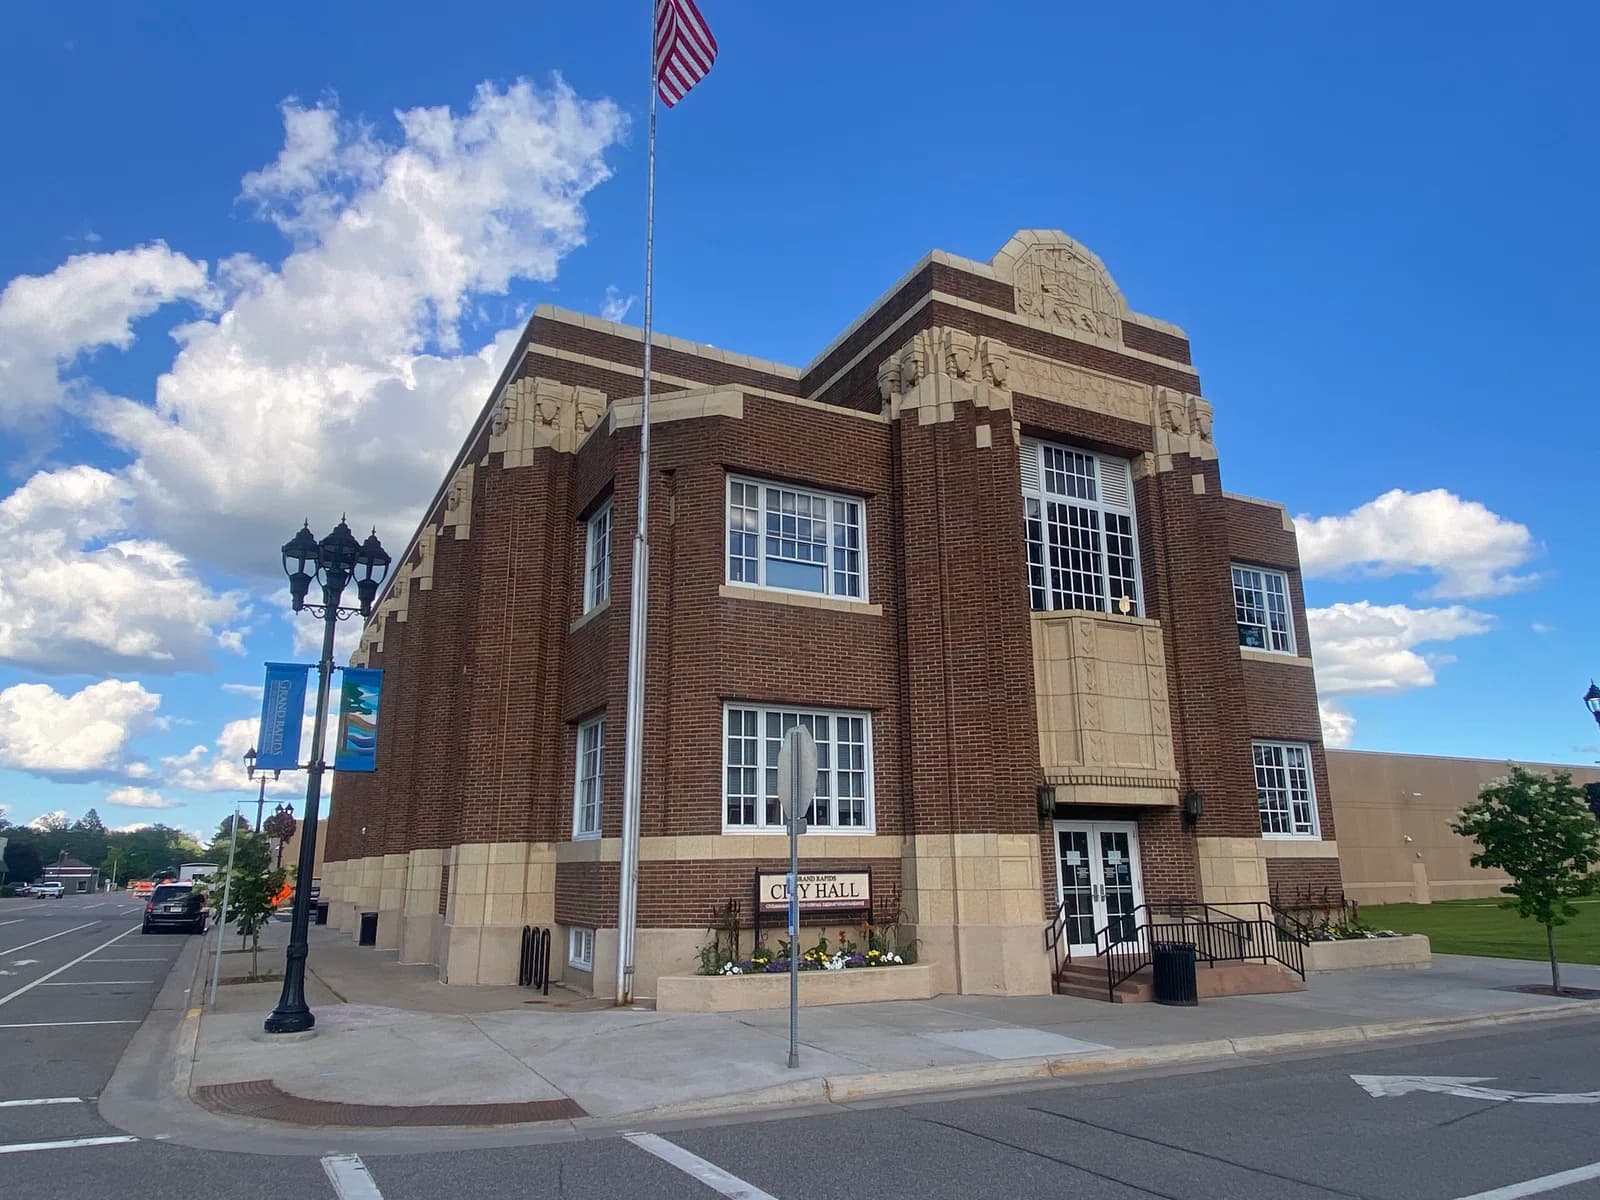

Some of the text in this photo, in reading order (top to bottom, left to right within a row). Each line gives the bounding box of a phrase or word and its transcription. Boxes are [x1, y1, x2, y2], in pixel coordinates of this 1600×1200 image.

[277, 680, 291, 718] GRAND
[770, 882, 860, 900] CIY HALL
